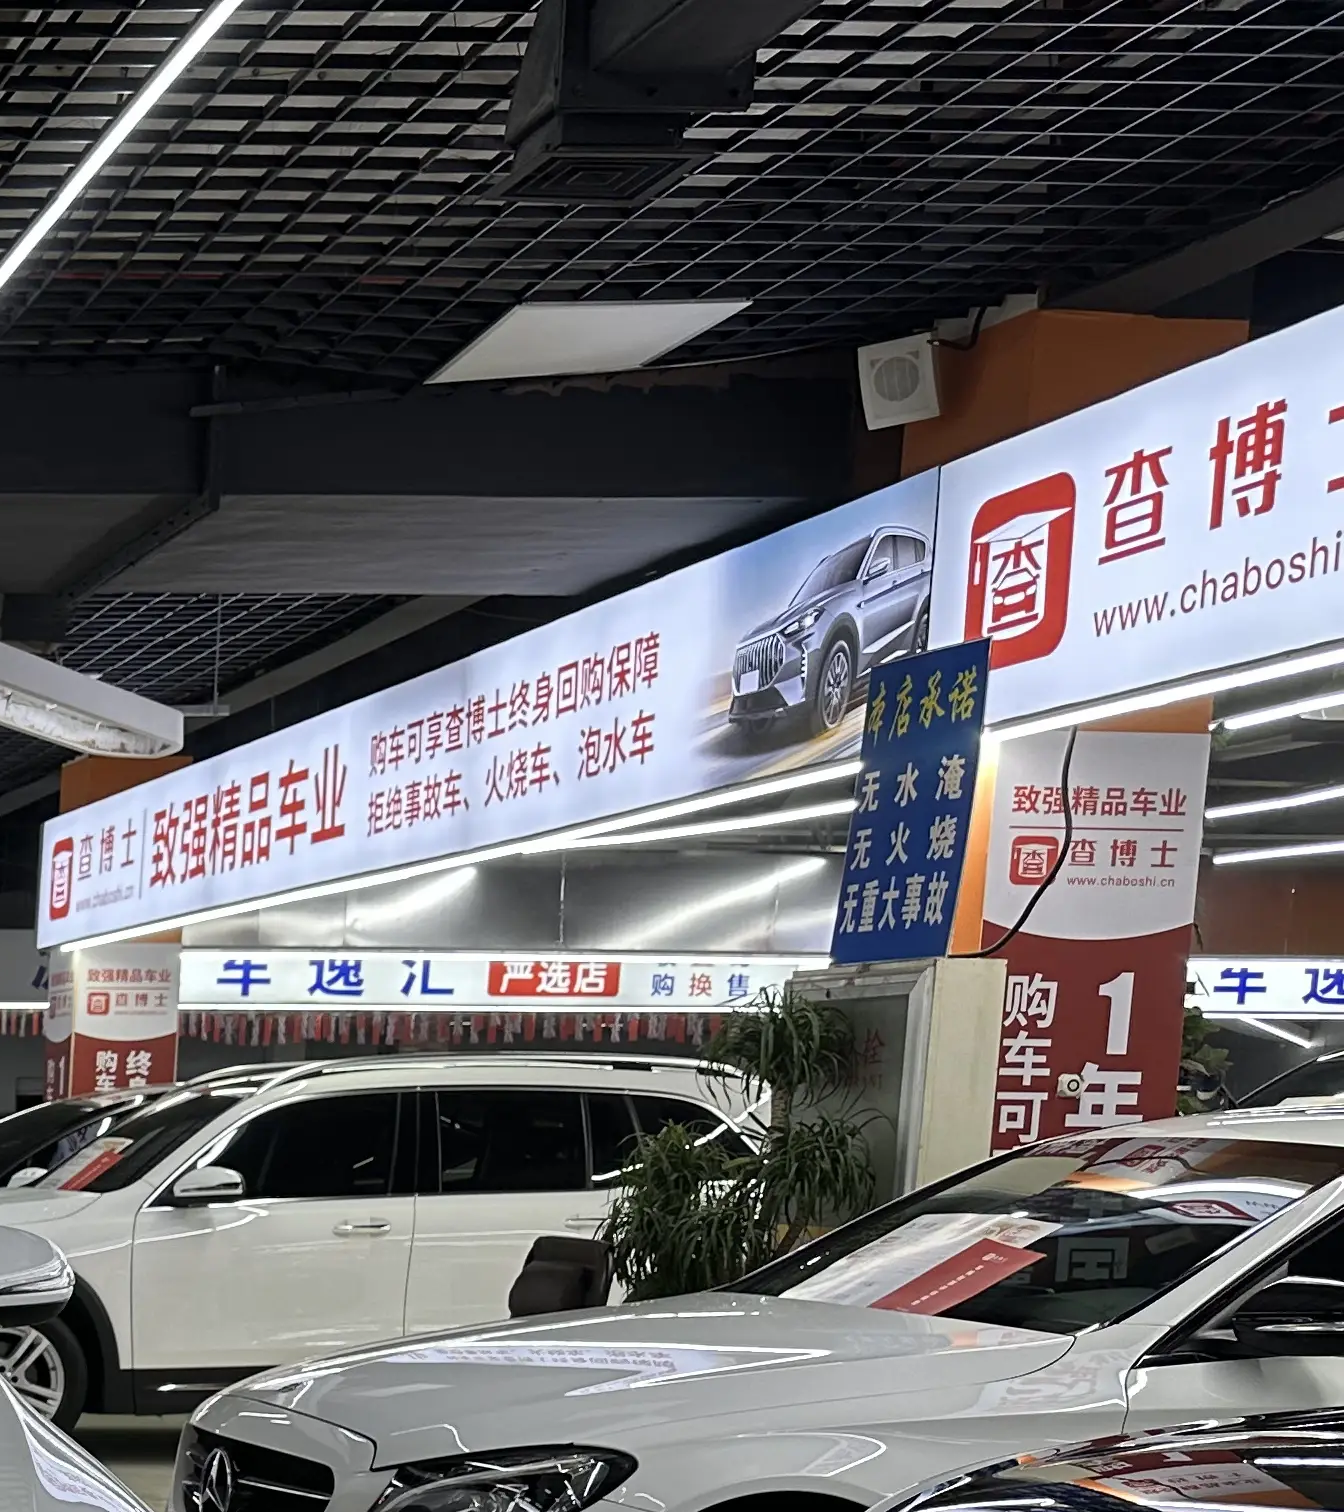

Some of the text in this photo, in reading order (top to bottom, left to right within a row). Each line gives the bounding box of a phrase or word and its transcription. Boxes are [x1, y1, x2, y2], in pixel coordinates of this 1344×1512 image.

[368, 631, 660, 778] 购车可享查博士终身回购保障
[866, 665, 979, 748] 本店承诺
[367, 709, 656, 838] 拒绝事故车、火烧车、泡水车
[858, 754, 966, 814] 无水淹
[1012, 785, 1187, 816] 致强精品车业
[148, 743, 348, 892] 致强精品车业
[849, 814, 958, 872] 无火烧
[77, 818, 137, 881] 查博士
[1068, 839, 1178, 868] 查博士
[839, 870, 950, 934] 无重大事故
[1067, 876, 1175, 888] www.chaboshi.cn
[87, 969, 172, 984] 致强精品车业
[499, 962, 608, 993] 严选店
[651, 974, 750, 997] 购换售
[993, 973, 1058, 1150] 购车可
